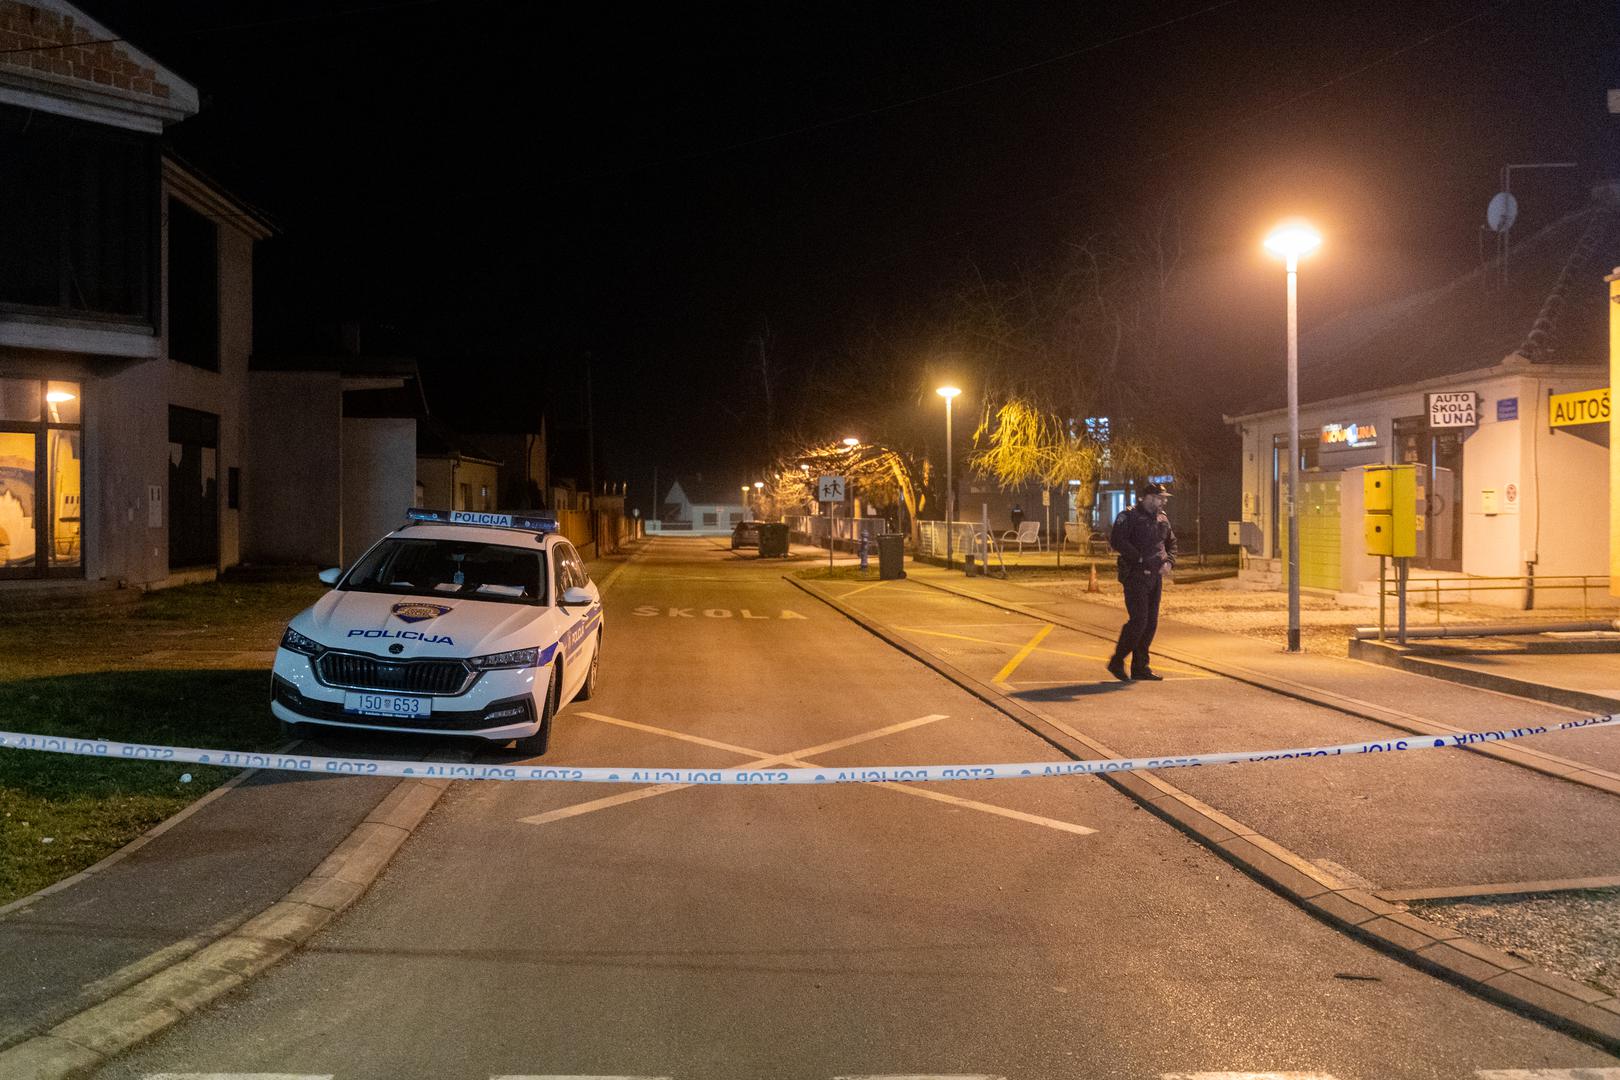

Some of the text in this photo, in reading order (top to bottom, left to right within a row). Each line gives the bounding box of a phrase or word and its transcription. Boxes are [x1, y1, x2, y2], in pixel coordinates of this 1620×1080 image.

[1435, 393, 1470, 403] AUTO
[1554, 392, 1610, 422] AUTOŠ
[1433, 413, 1474, 425] LUNA
[454, 512, 508, 526] POLICIJA
[347, 629, 454, 646] POLICIJA
[393, 697, 419, 713] 653
